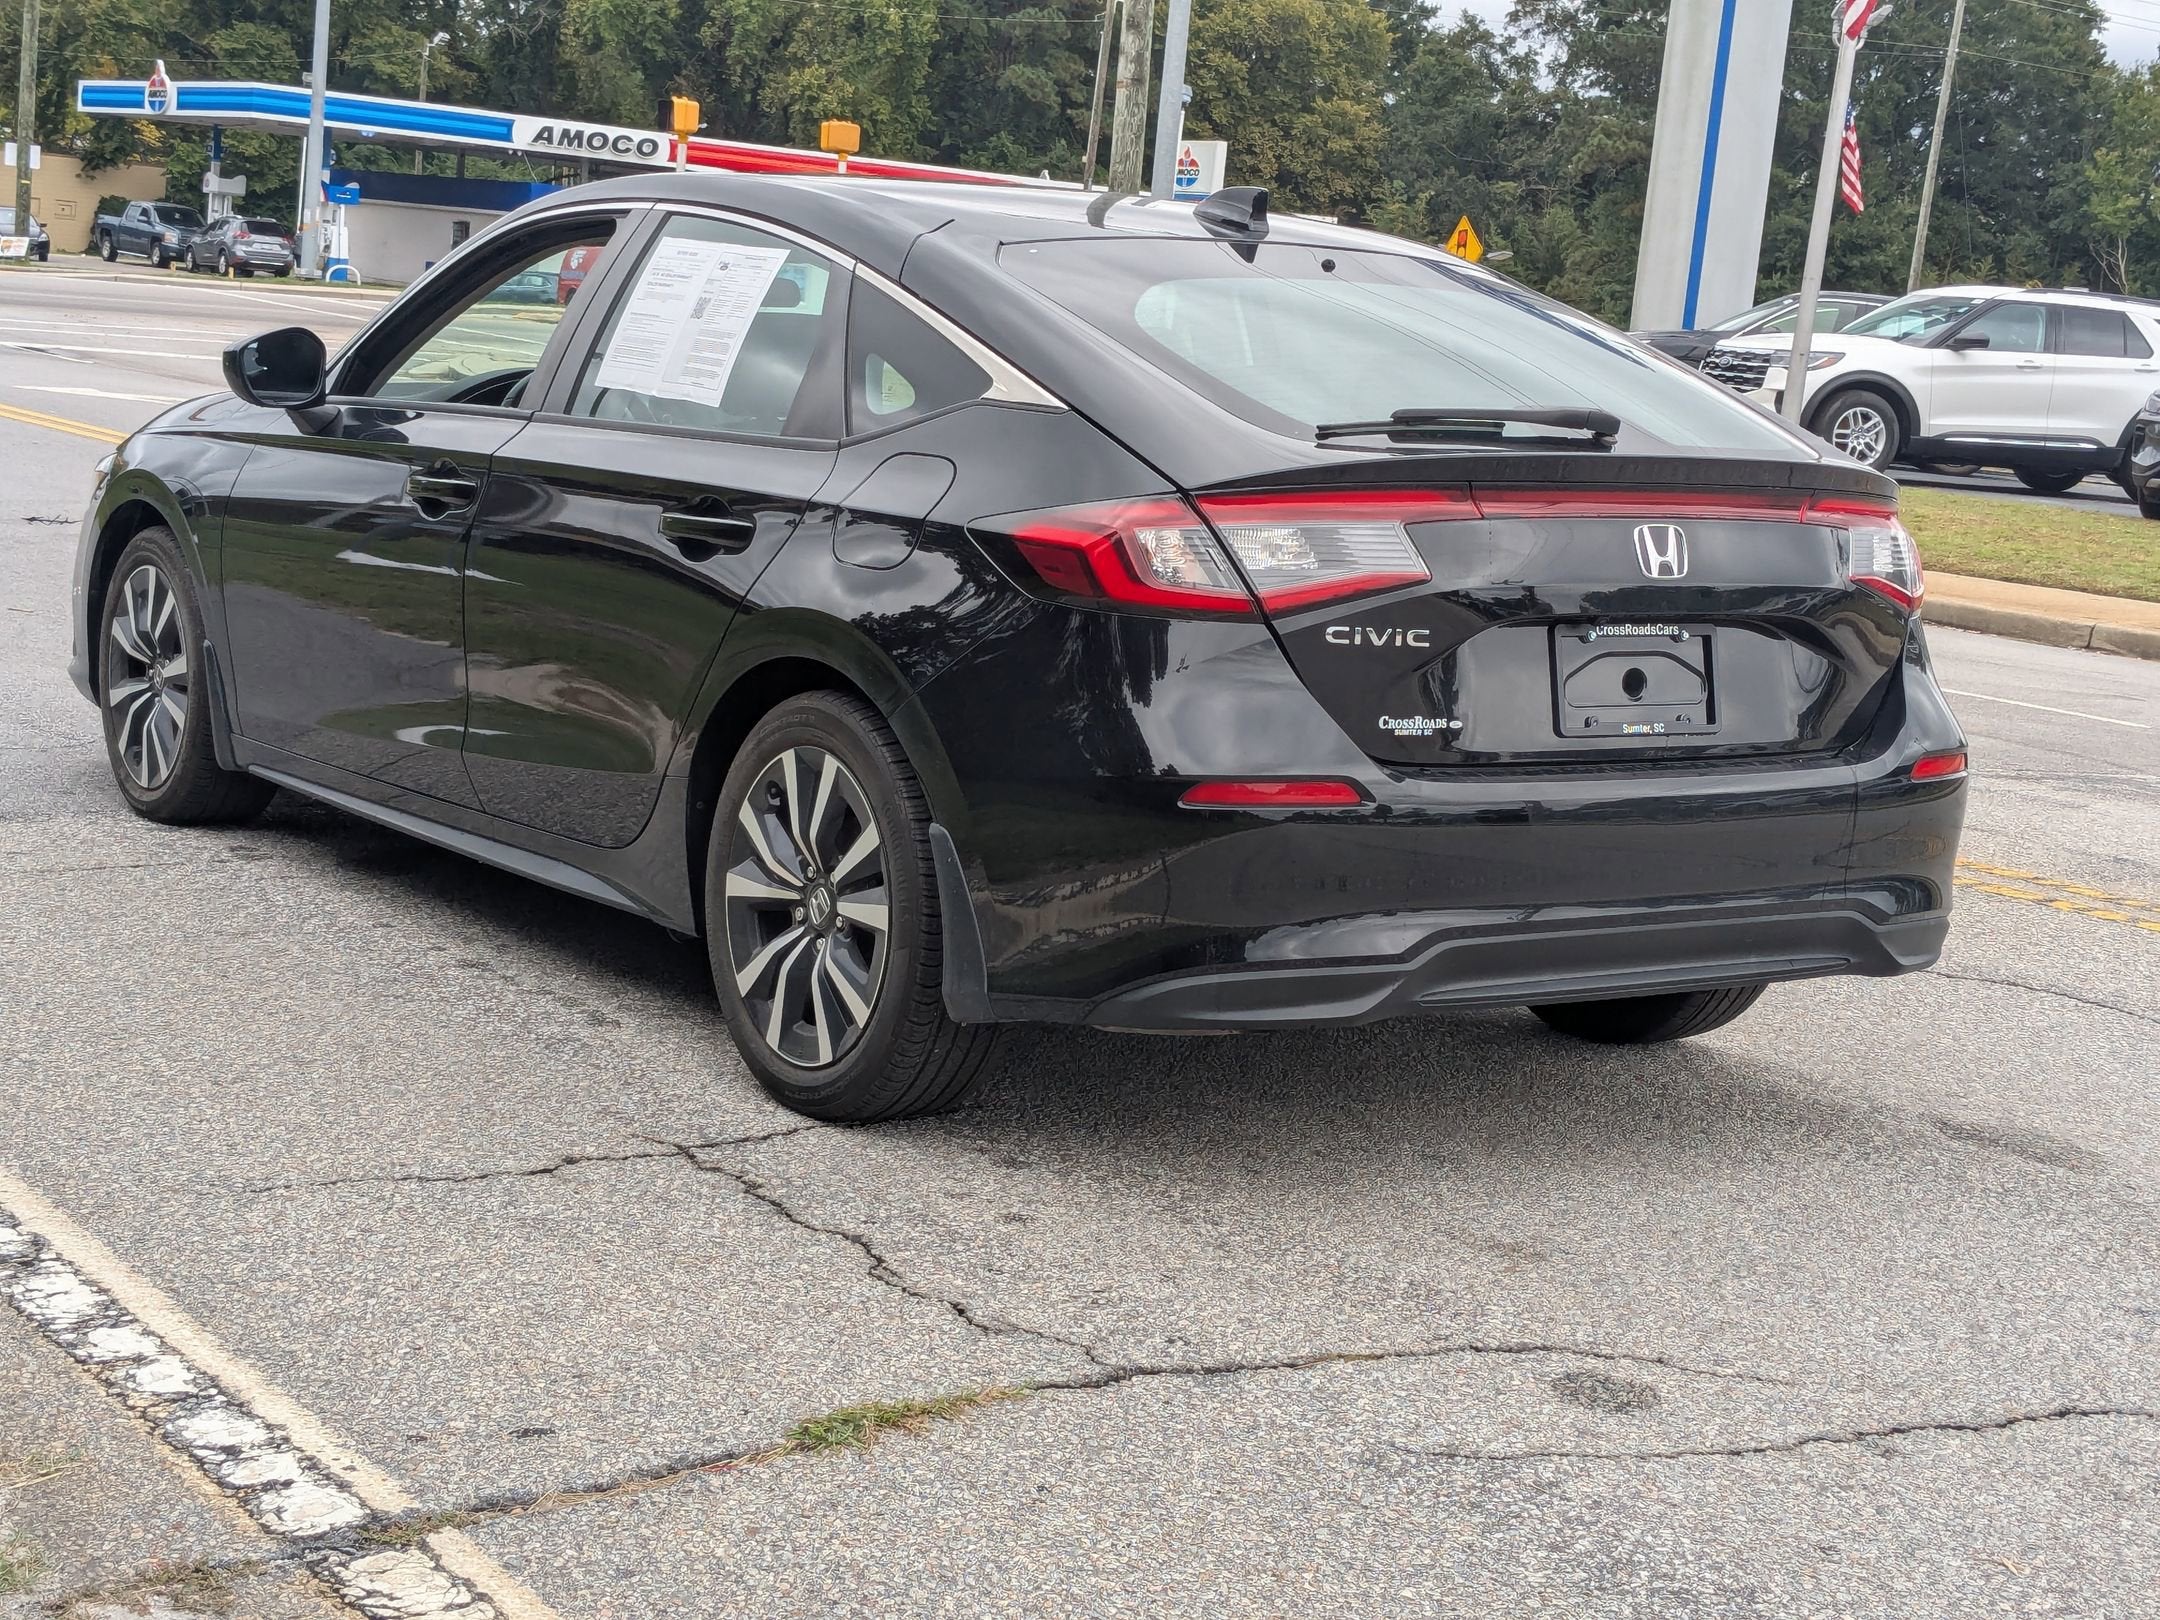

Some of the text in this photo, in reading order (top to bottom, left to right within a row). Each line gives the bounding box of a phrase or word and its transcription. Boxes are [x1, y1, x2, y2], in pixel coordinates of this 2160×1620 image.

[530, 126, 659, 158] AMOCO
[1325, 626, 1430, 647] CIVIC
[1596, 623, 1679, 635] CrossRoadsCars
[1622, 723, 1665, 734] Sumter, SC
